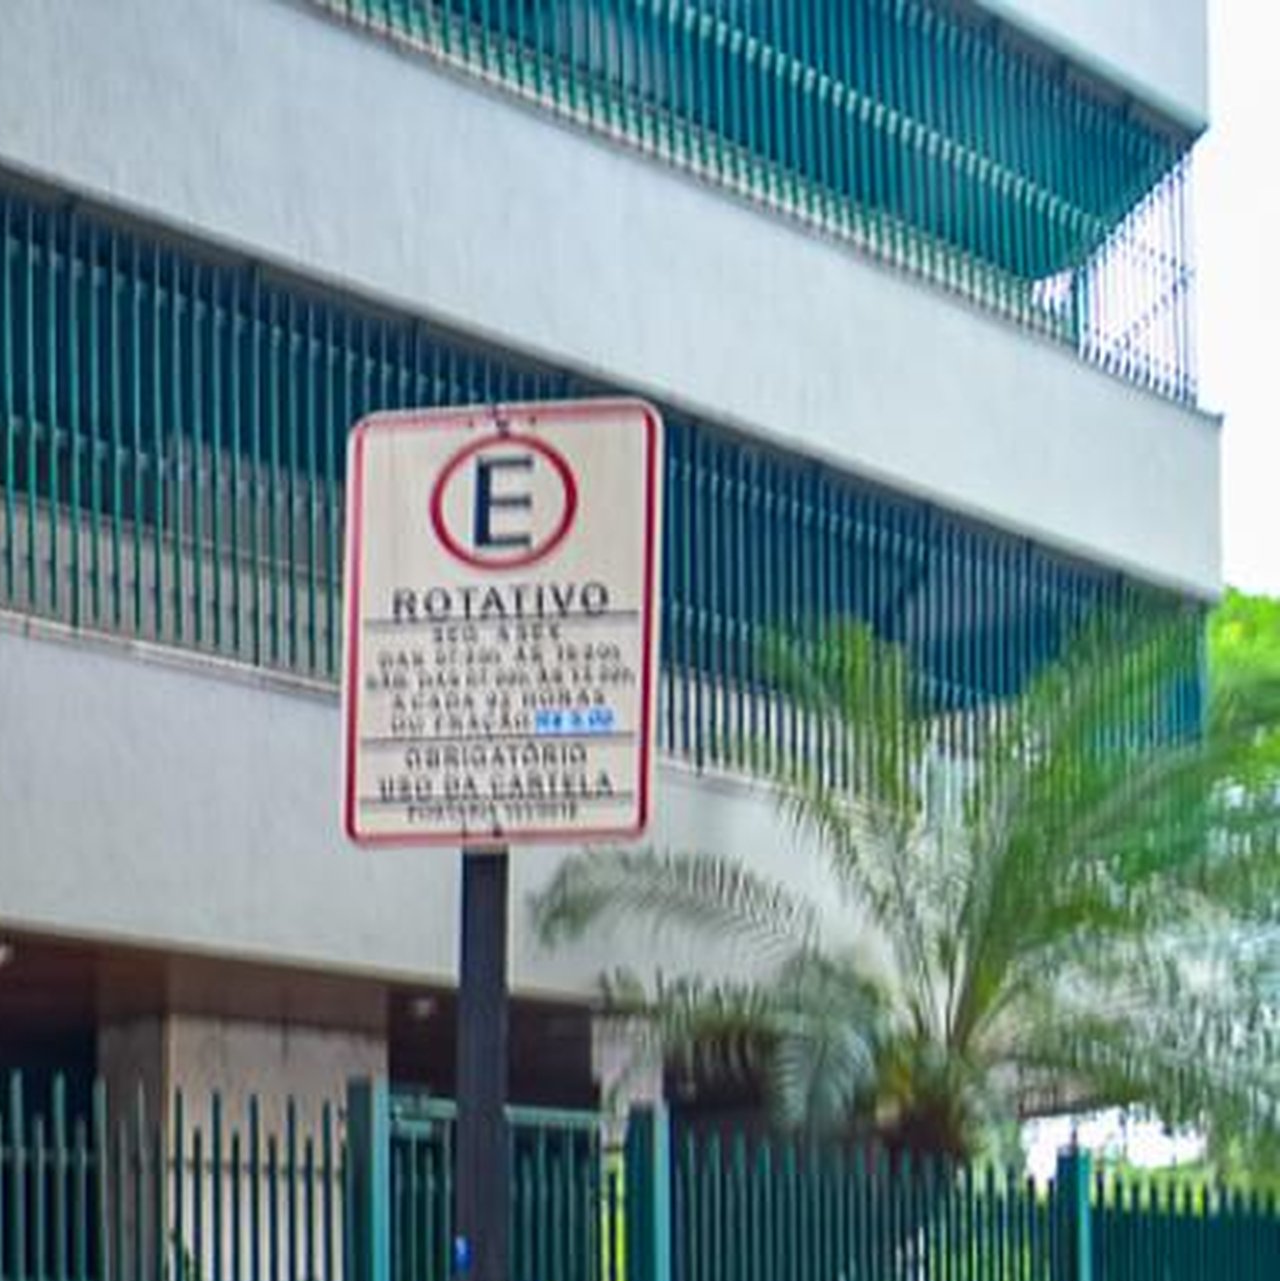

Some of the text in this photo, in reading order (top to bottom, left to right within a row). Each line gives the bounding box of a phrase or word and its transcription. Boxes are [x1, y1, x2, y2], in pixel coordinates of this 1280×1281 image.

[473, 455, 534, 550] E
[392, 583, 610, 624] ROTATIVO
[405, 742, 587, 769] OBRIGATÓRIO
[490, 770, 614, 800] CARTELA
